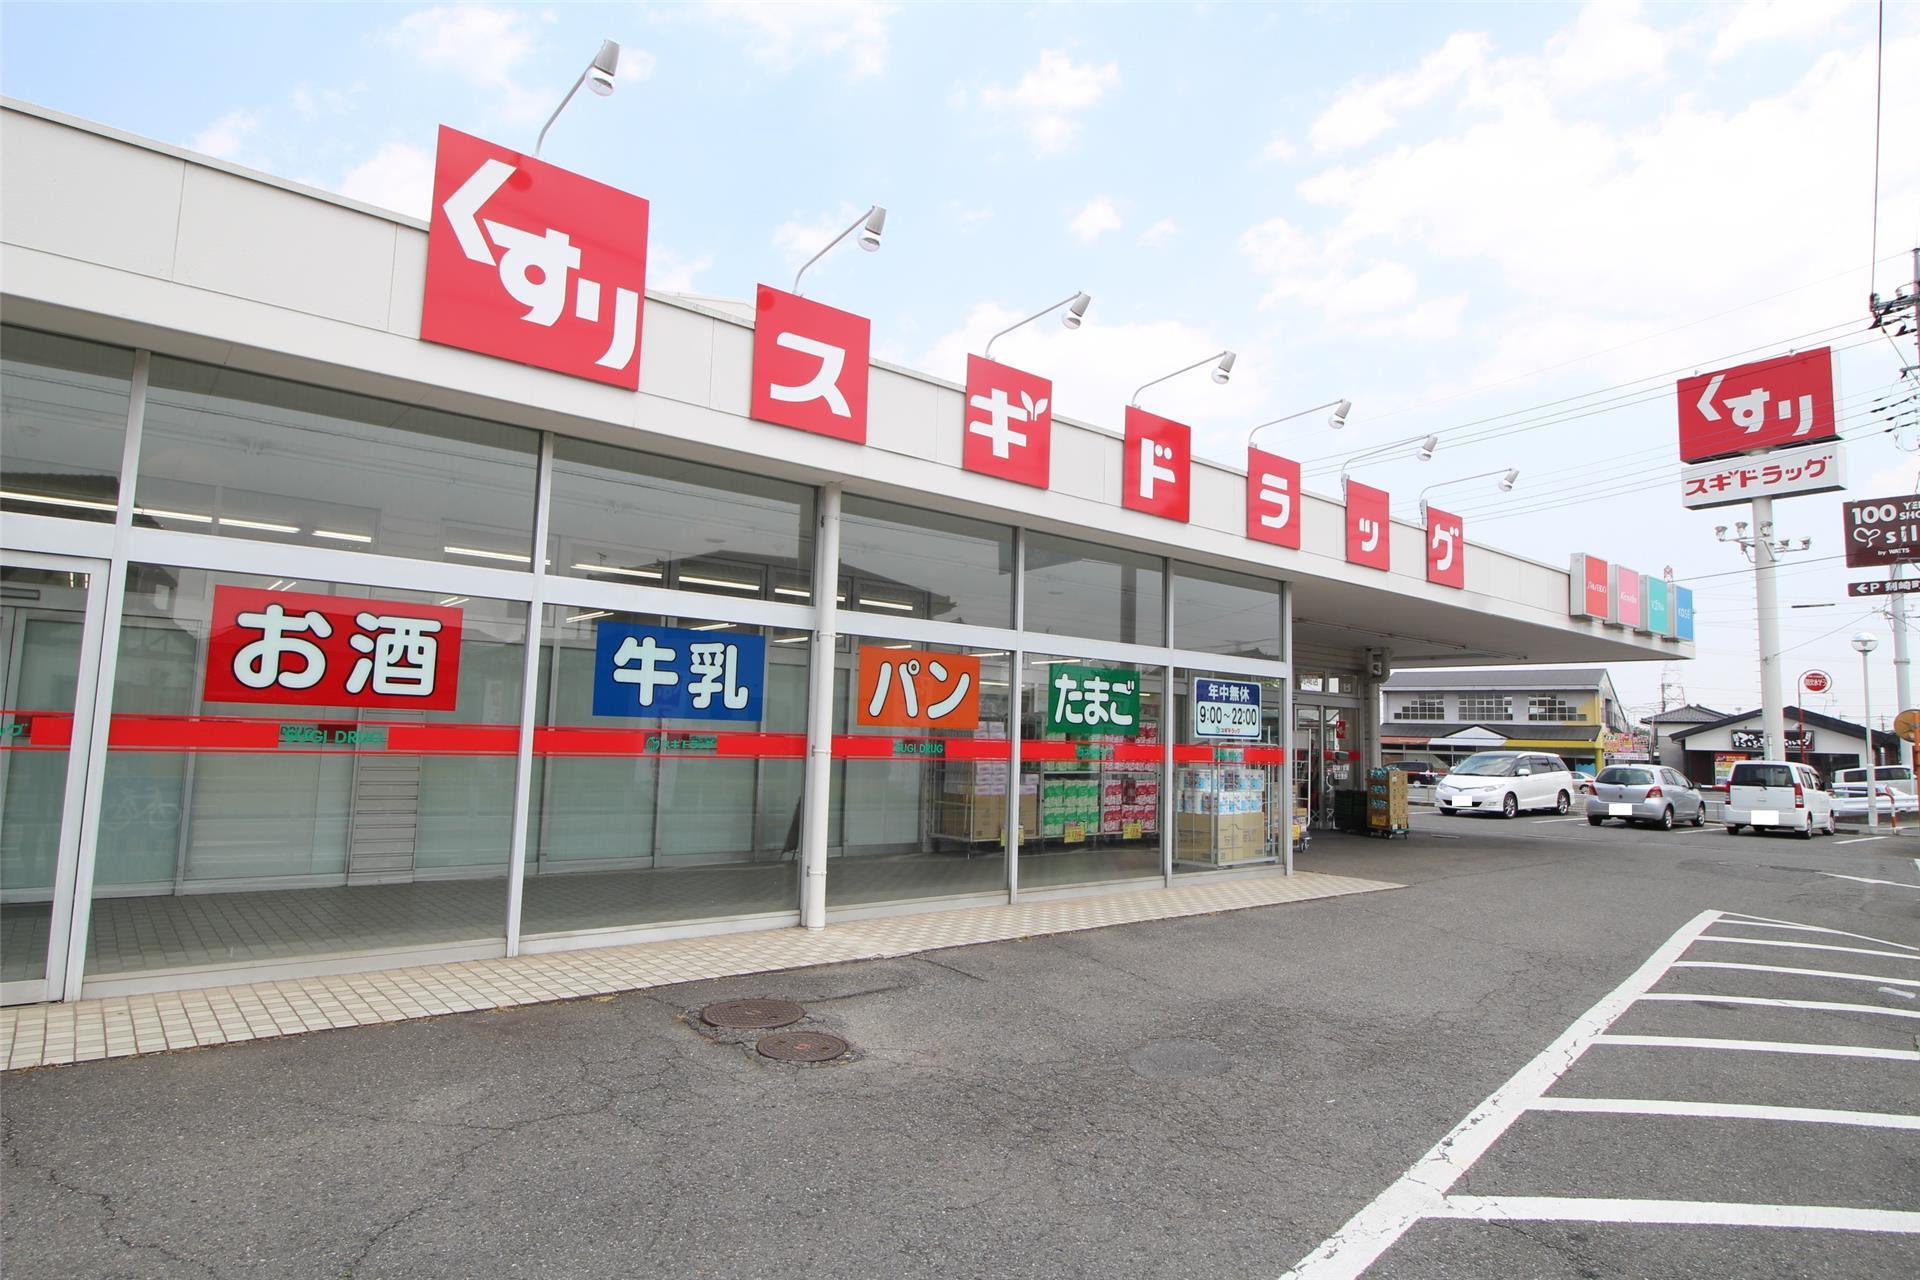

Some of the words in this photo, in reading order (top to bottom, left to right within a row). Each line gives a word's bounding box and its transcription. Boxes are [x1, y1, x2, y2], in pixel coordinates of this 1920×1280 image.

[442, 158, 639, 370] くすり
[1697, 374, 1813, 436] くすり
[1685, 455, 1832, 496] スギドラッグ
[1852, 504, 1897, 525] 100
[1870, 583, 1880, 592] P
[231, 602, 442, 697] お酒
[612, 635, 749, 711] 牛乳
[867, 658, 971, 720] パン
[1054, 673, 1136, 726] たまご
[1208, 683, 1250, 702] 年中無休
[919, 743, 944, 753] DRUG
